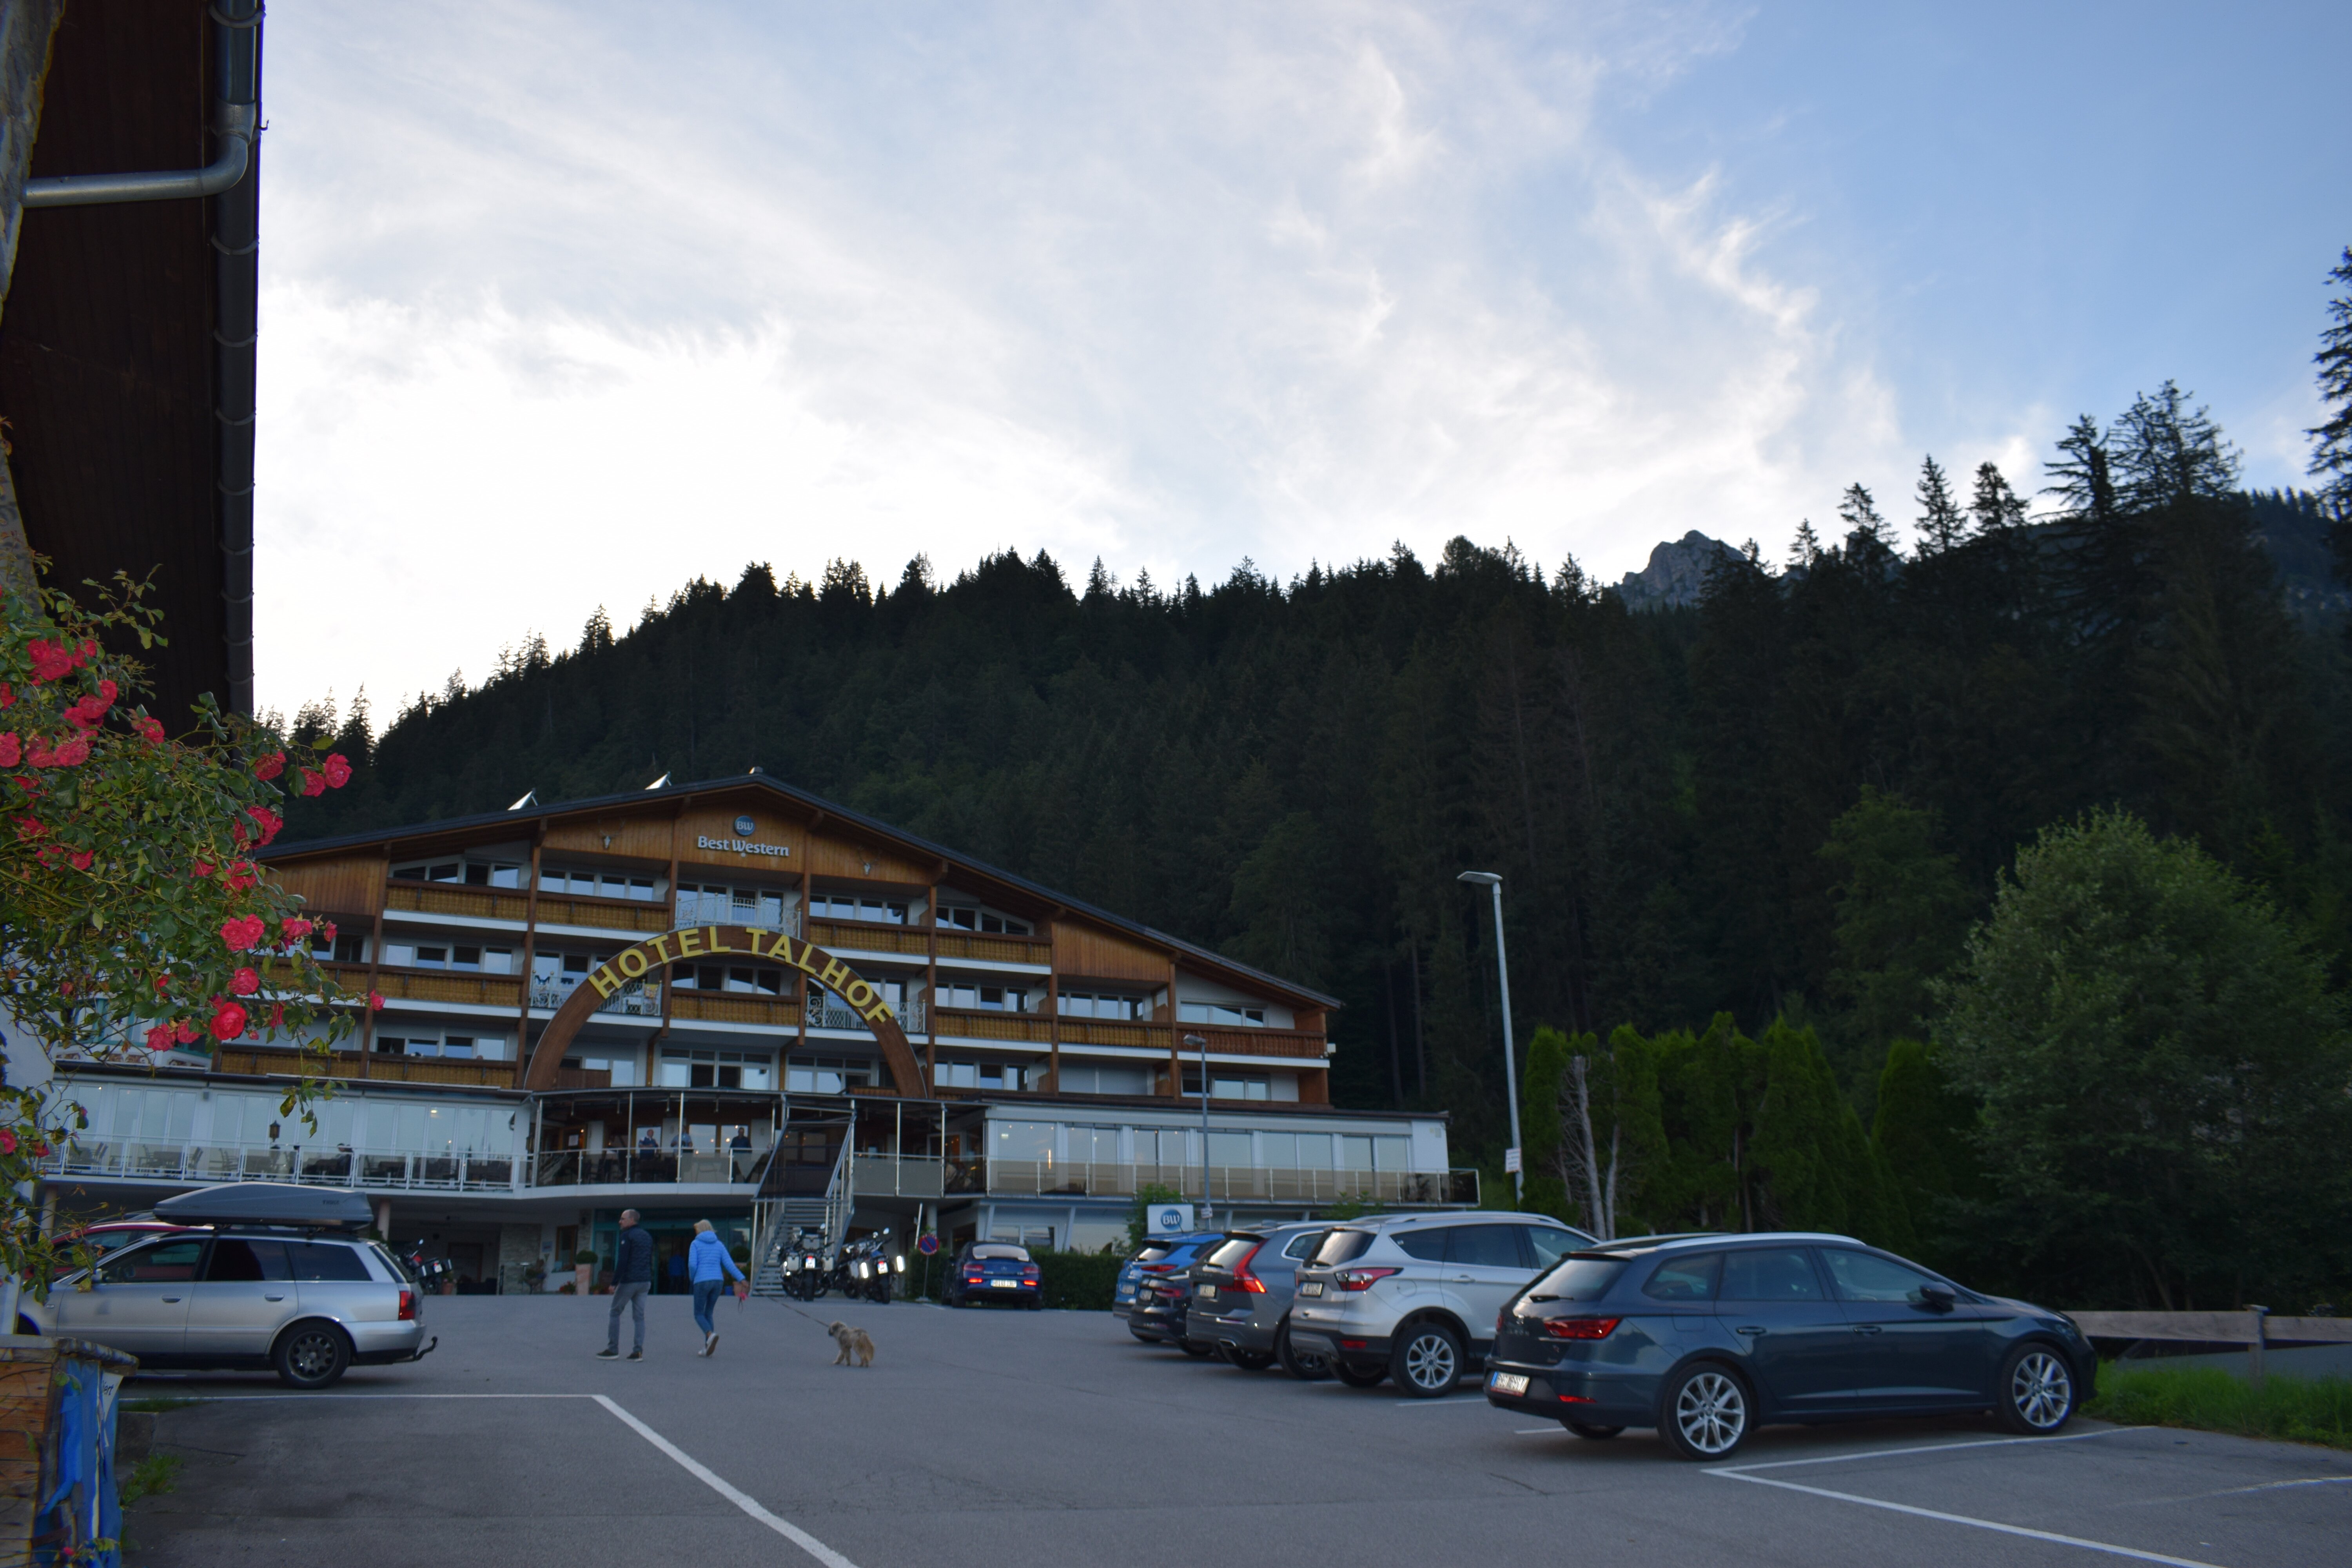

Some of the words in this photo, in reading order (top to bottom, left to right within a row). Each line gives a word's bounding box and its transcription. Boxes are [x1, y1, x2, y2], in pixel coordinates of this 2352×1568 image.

[736, 821, 753, 830] BW
[698, 835, 730, 851] Best
[732, 839, 789, 856] Western
[588, 926, 731, 999] HOTEL
[746, 927, 895, 1023] TALHOF
[1163, 1214, 1180, 1225] BW
